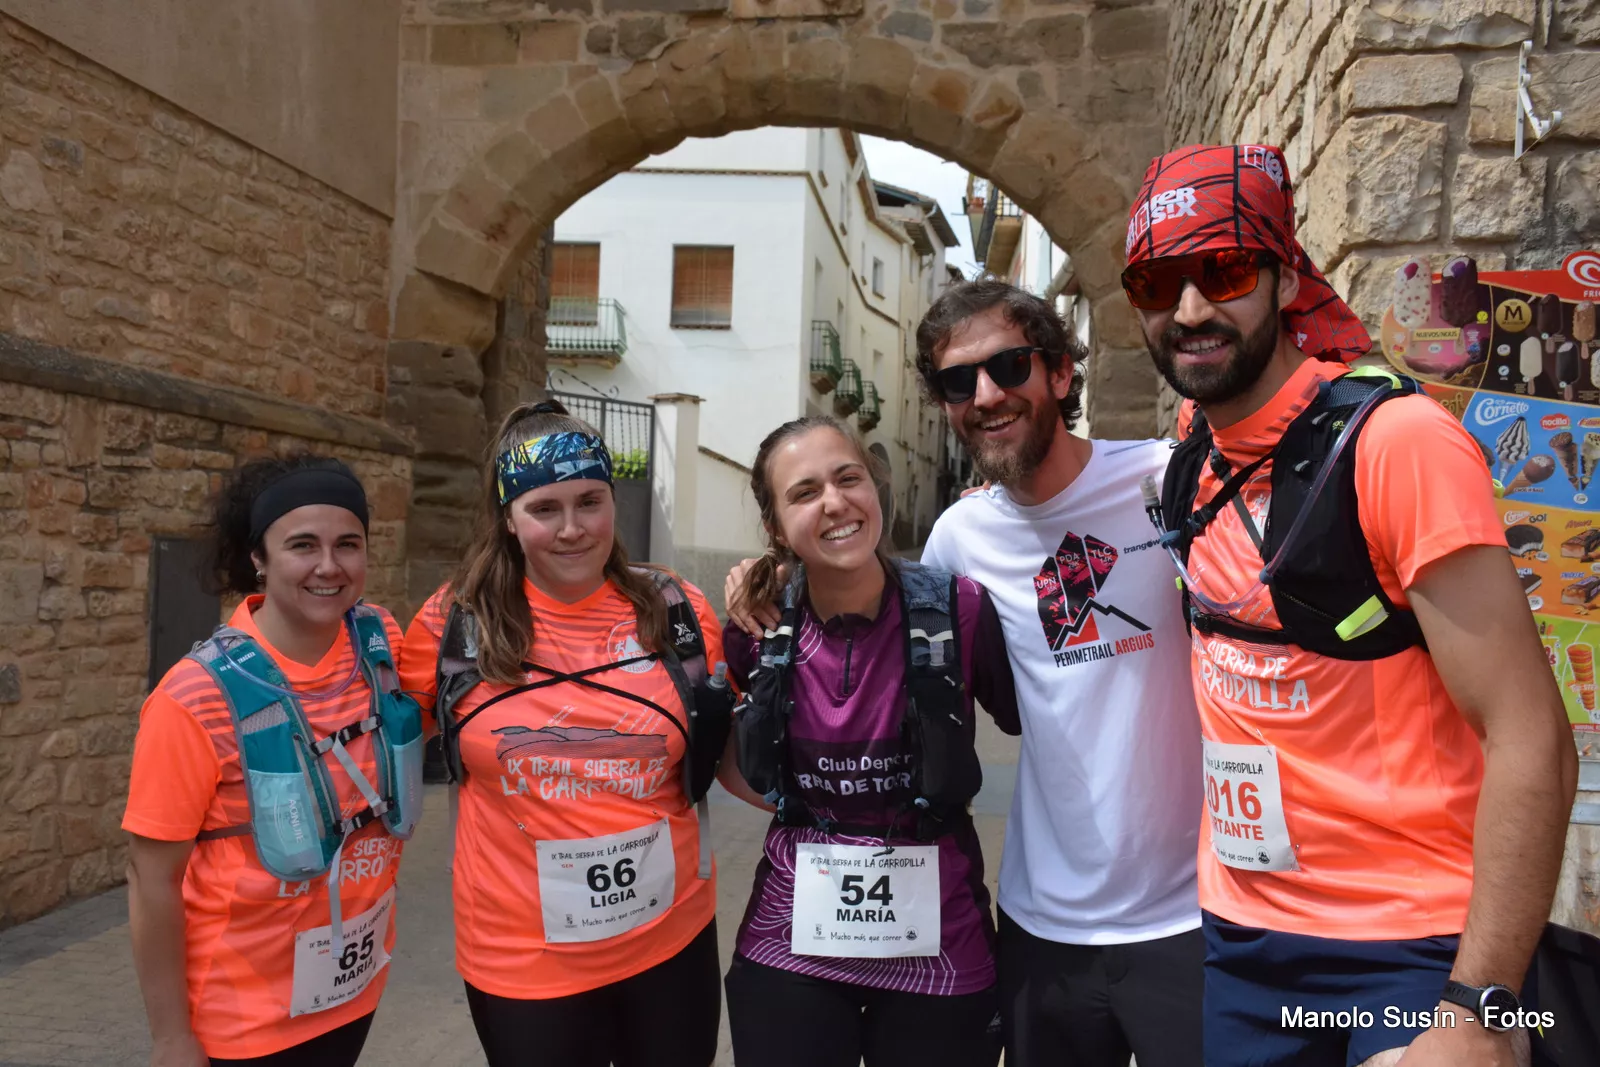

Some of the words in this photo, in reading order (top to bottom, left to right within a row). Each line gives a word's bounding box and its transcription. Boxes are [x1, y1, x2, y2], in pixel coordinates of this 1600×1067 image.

[1583, 290, 1600, 298] FRI
[1504, 305, 1523, 321] M
[1475, 397, 1529, 426] Cornetto
[1060, 553, 1080, 564] PDA
[1091, 546, 1111, 559] TLC
[1036, 576, 1056, 589] UPN
[1054, 642, 1115, 668] PERIMETRAIL
[1115, 633, 1155, 655] ARGUIS
[1207, 640, 1257, 676] SIERRA
[1260, 656, 1288, 680] DE
[507, 758, 524, 776] IX
[528, 757, 576, 777] TRAIL
[584, 759, 641, 779] SIERRA
[646, 755, 668, 774] DE
[818, 756, 856, 772] Club
[1221, 761, 1264, 775] CARRODILLA
[500, 775, 531, 797] LA
[840, 778, 869, 796] DE
[1206, 771, 1262, 821] 016
[558, 852, 574, 860] TRAIL
[575, 850, 595, 859] SIERRA
[607, 844, 618, 856] LA
[620, 831, 659, 852] CARRODILLA
[817, 857, 831, 865] TRAIL
[832, 858, 852, 867] SIERRA
[853, 859, 861, 867] DE
[864, 858, 876, 868] LA
[878, 858, 926, 869] CARRODILLA
[1237, 855, 1254, 863] correr
[586, 857, 637, 893] 66
[590, 888, 637, 908] LIGIA
[840, 874, 894, 906] 54
[582, 917, 603, 927] Mucho
[629, 906, 647, 915] correr
[836, 906, 897, 922] MARÍA
[359, 923, 368, 932] LA
[830, 931, 852, 941] Mucho
[853, 933, 866, 941] más
[869, 934, 880, 943] que
[339, 930, 375, 971] 65
